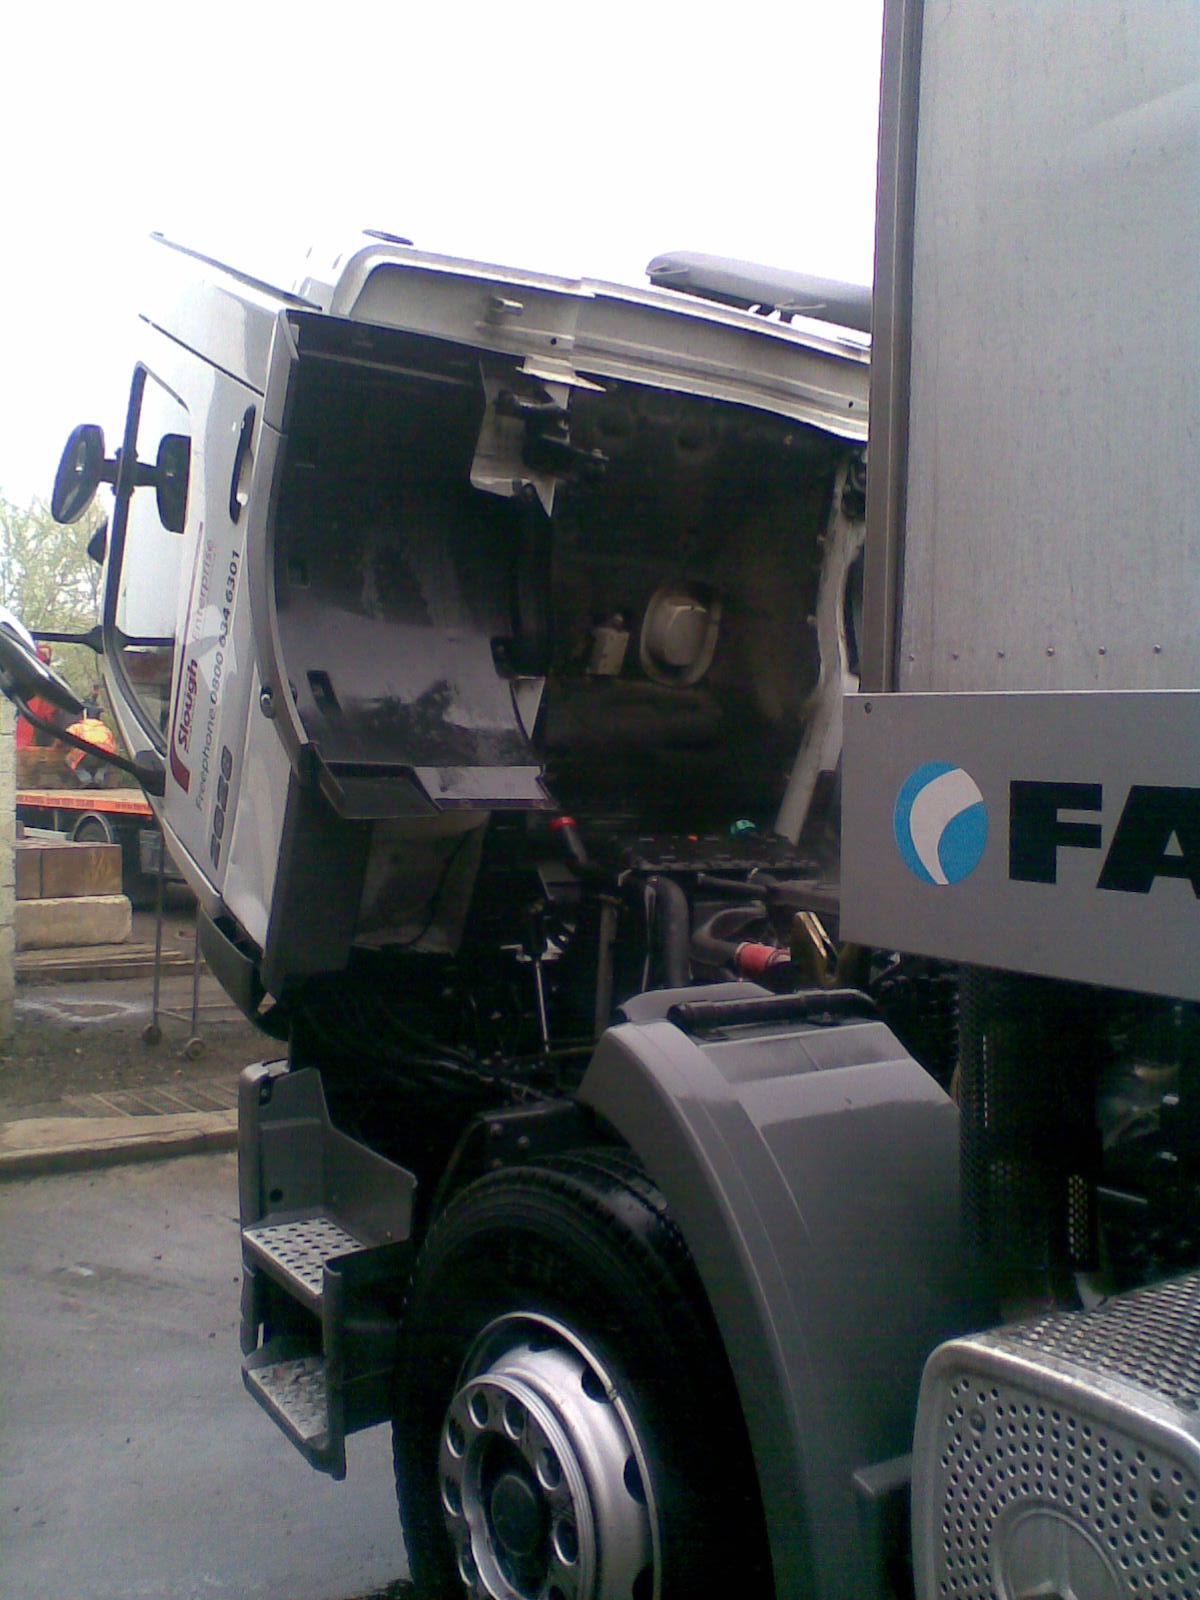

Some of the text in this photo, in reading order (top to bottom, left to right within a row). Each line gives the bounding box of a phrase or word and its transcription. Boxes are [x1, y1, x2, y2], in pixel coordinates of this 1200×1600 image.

[178, 539, 214, 754] Slough Enterprise
[196, 550, 240, 811] Freephone 0800 634 6301
[1009, 780, 1200, 899] FA
